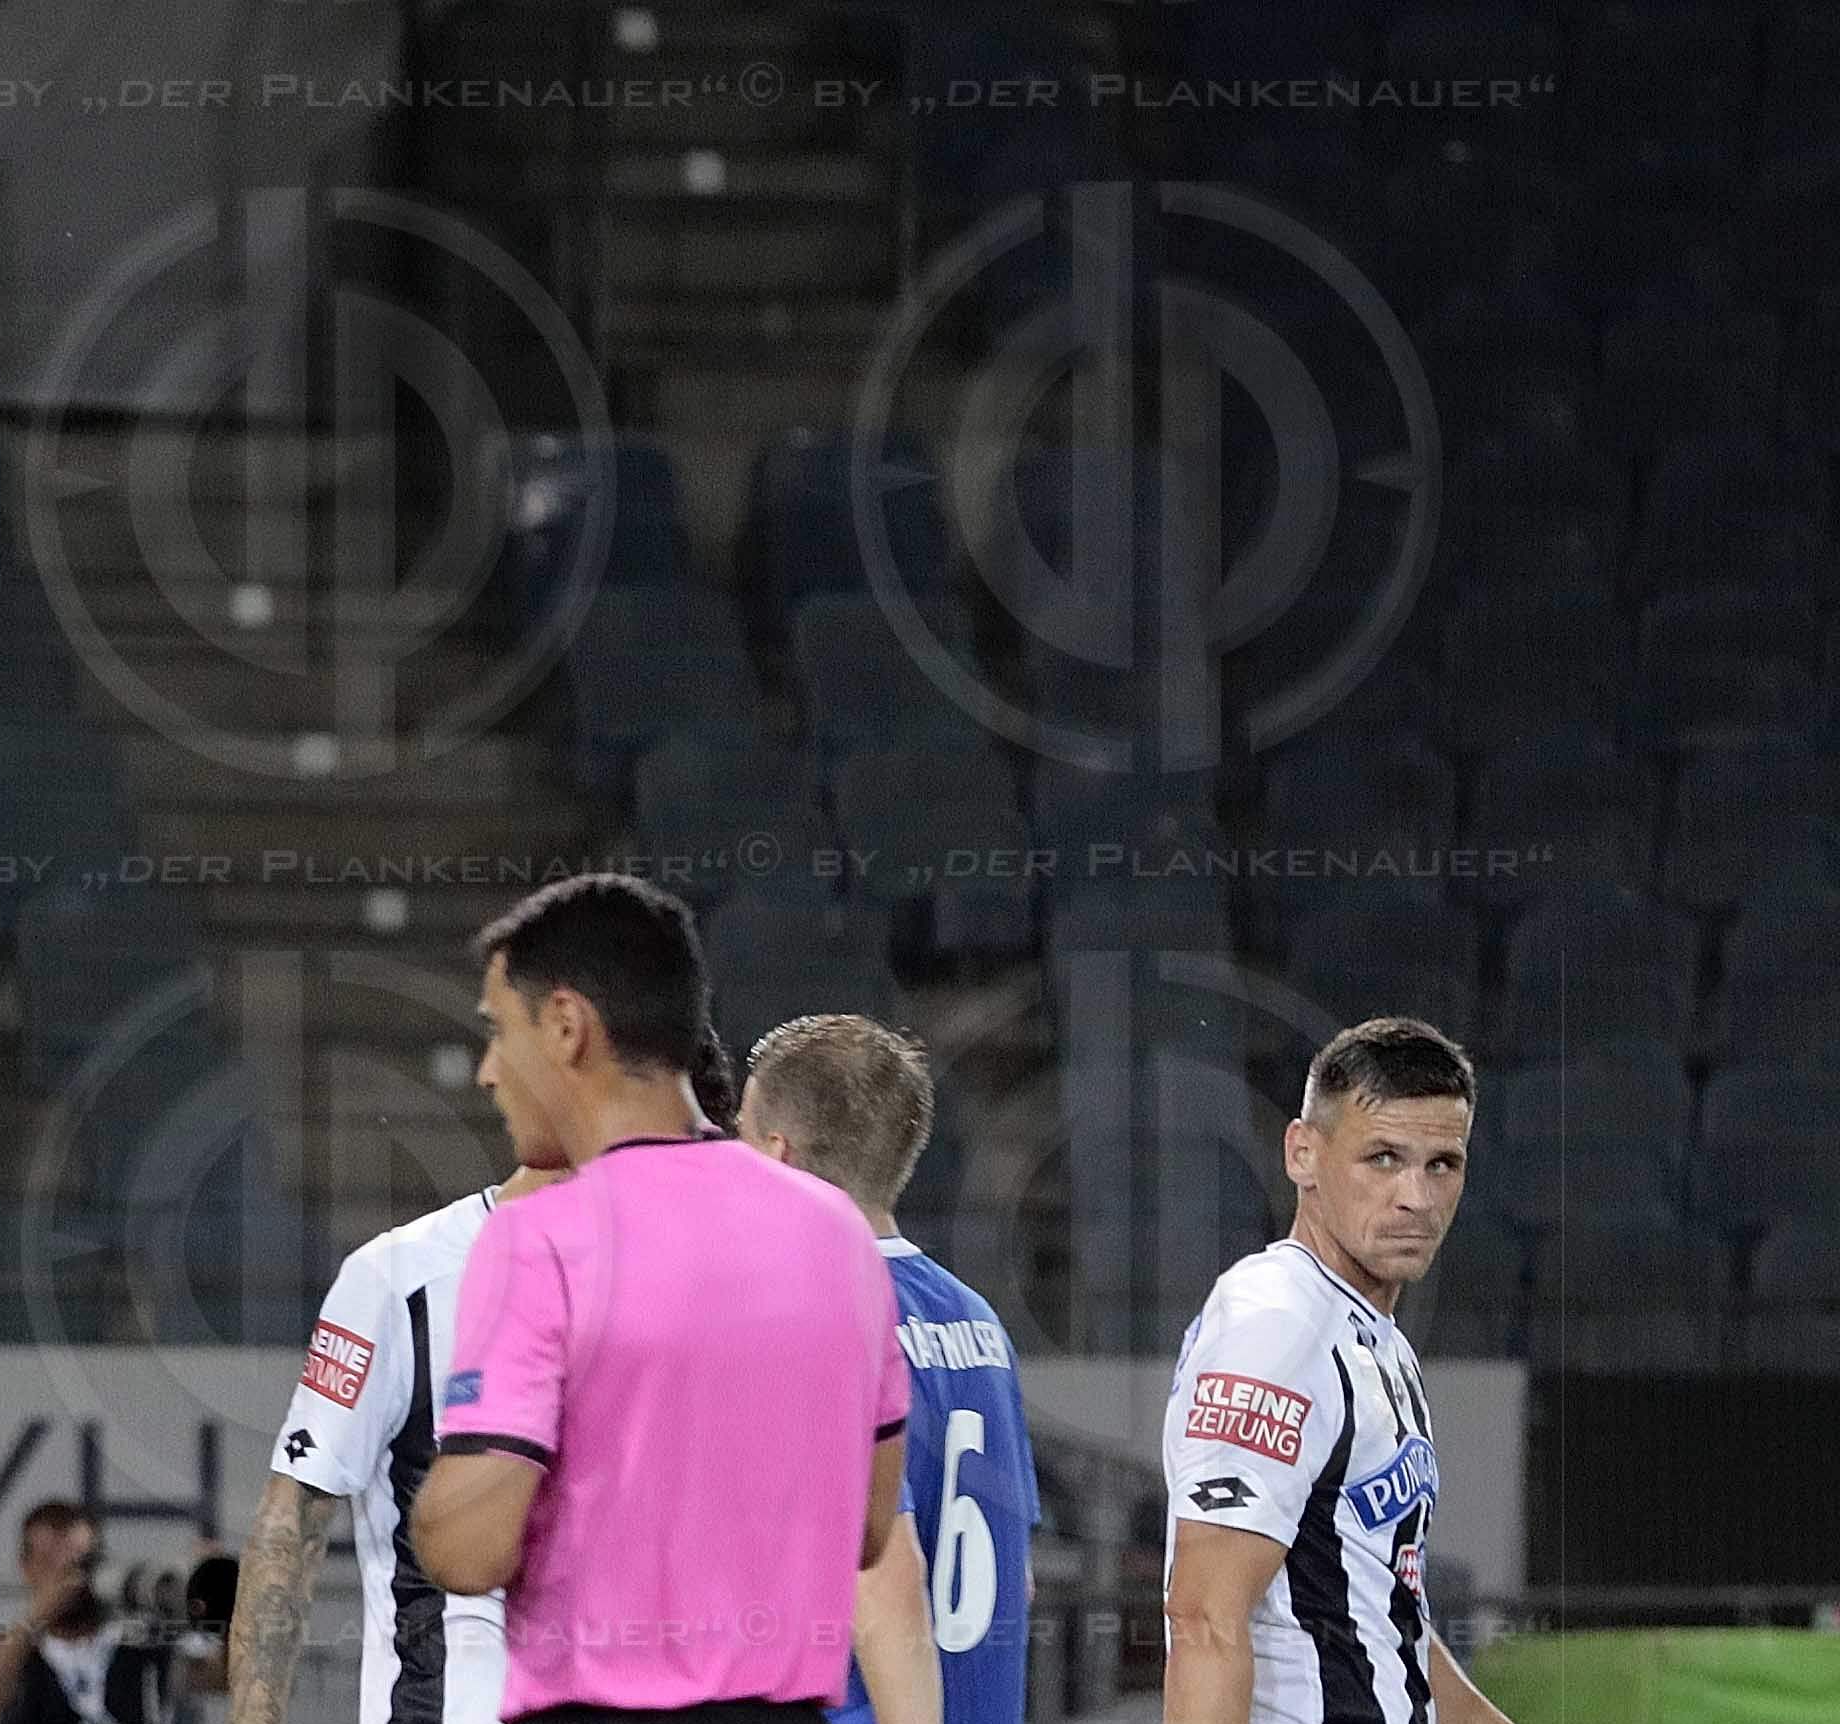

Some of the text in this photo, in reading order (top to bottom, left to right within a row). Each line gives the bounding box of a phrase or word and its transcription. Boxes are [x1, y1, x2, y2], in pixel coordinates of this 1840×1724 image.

[1196, 1376, 1306, 1428] KLEINE
[1188, 1405, 1301, 1457] ZEITUNG
[932, 1409, 998, 1653] 6
